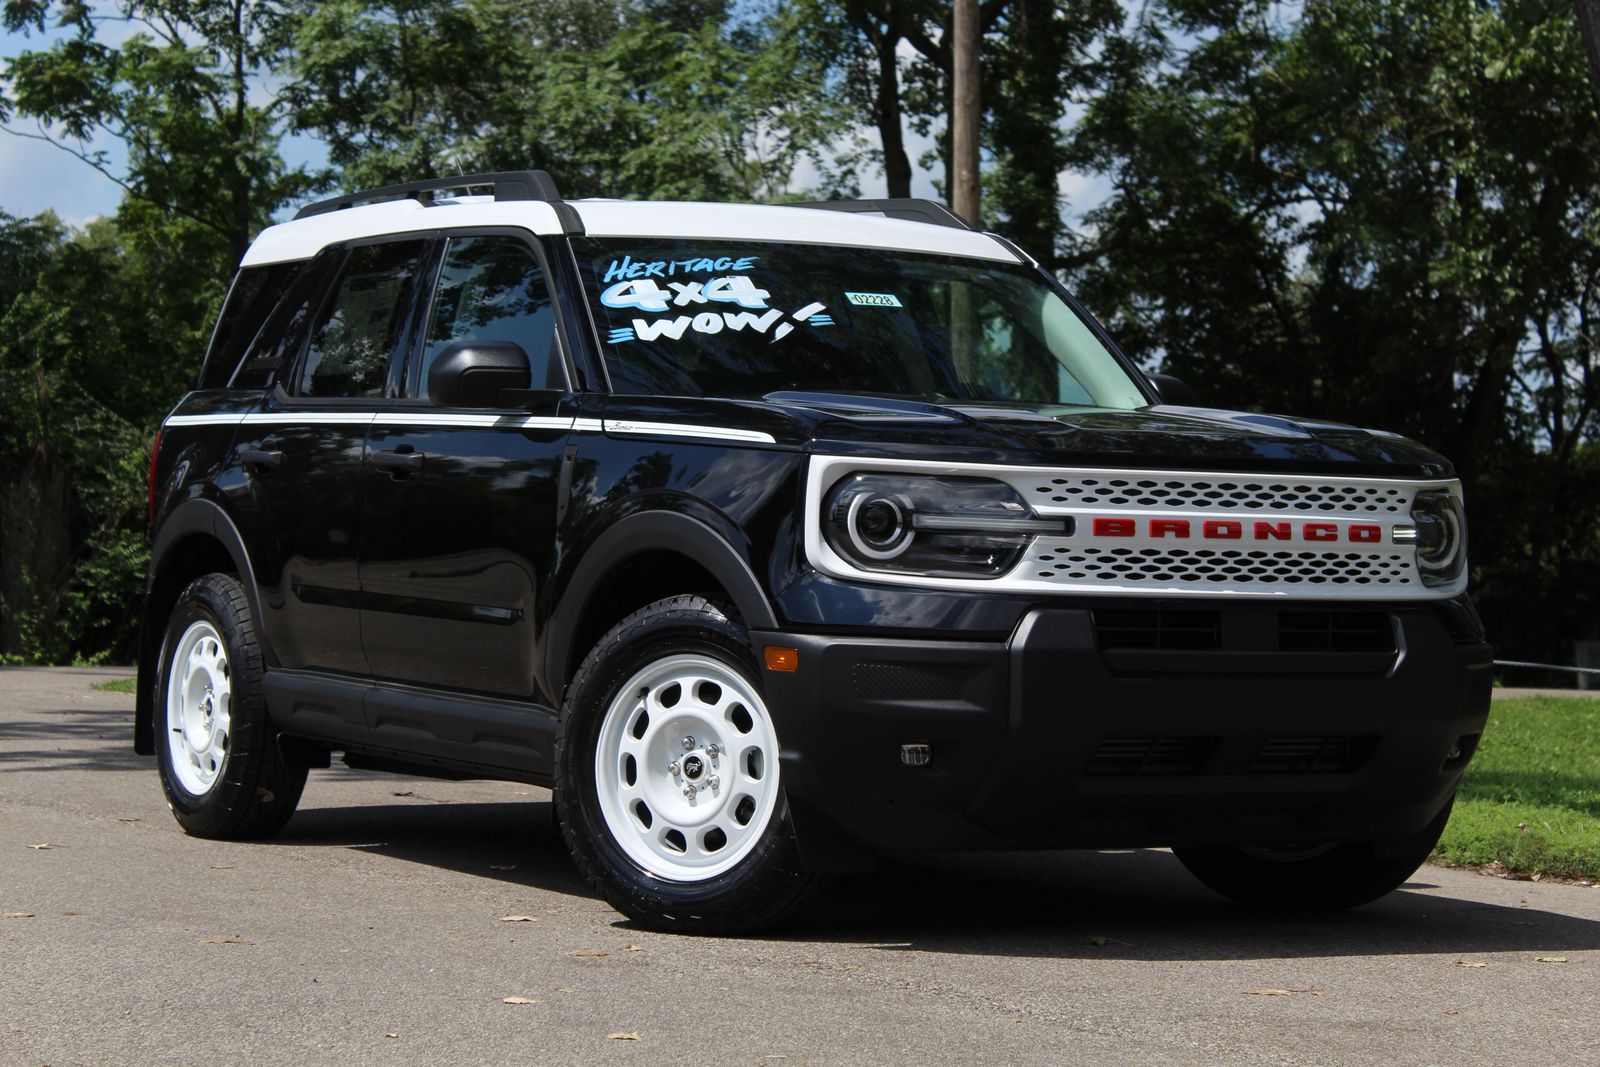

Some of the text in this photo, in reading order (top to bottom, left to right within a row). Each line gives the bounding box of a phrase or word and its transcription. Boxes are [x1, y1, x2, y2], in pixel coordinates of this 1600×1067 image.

[603, 256, 760, 282] HERITAGE
[853, 294, 894, 306] 02228
[1093, 518, 1381, 543] BRONCO
